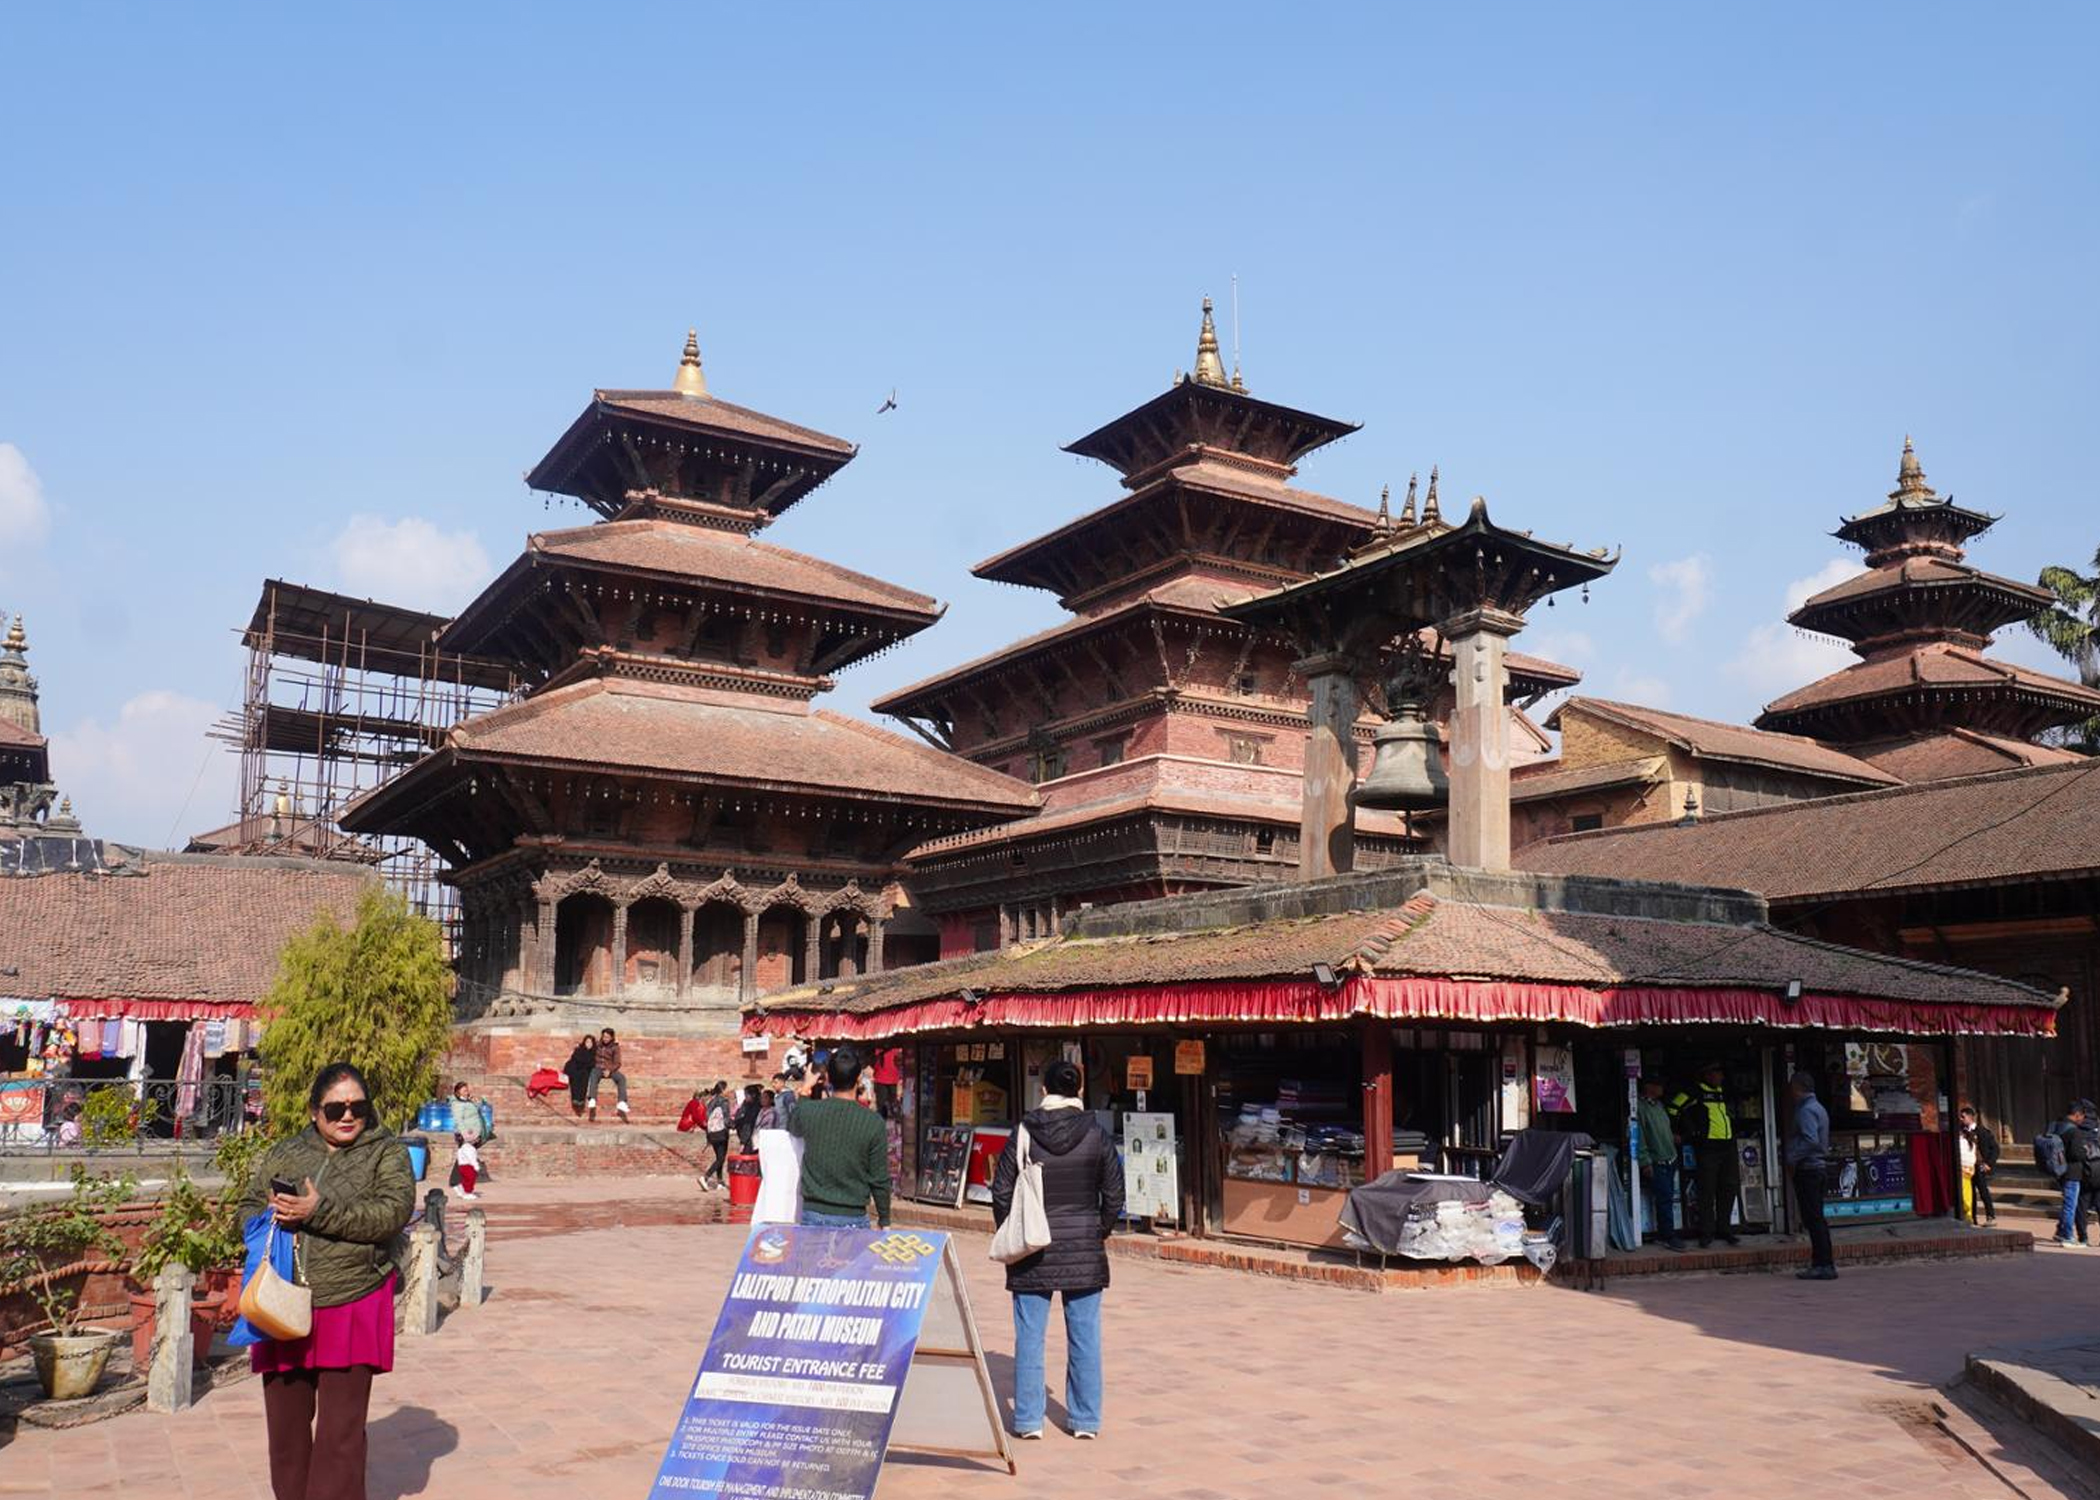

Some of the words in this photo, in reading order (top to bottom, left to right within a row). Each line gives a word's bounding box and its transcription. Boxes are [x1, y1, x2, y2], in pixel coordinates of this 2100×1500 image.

[731, 1273, 795, 1302] LALITPUR
[792, 1276, 893, 1307] METROPOLITAN
[890, 1281, 926, 1309] CITY
[747, 1311, 780, 1338] AND
[777, 1312, 823, 1342] PATAN
[819, 1315, 883, 1346] MUSEUM
[722, 1353, 781, 1372] TOURIST
[782, 1357, 857, 1378] ENTRANCE
[858, 1363, 886, 1380] FEE
[739, 1420, 760, 1429] VALID
[761, 1422, 776, 1430] FOR
[776, 1423, 790, 1432] THE
[812, 1426, 829, 1435] DATE
[735, 1428, 759, 1438] ENTRY
[760, 1430, 784, 1440] PLEASE
[784, 1433, 818, 1443] CONTACT
[819, 1435, 831, 1444] US
[831, 1437, 851, 1446] WITH
[852, 1439, 872, 1448] YOUR
[782, 1442, 798, 1451] SIZE
[798, 1443, 824, 1453] PHOTO
[824, 1446, 835, 1454] AT
[678, 1451, 705, 1460] TICKETS
[705, 1453, 727, 1462] ONCE
[727, 1455, 747, 1463] SOLD
[747, 1456, 764, 1465] CAN
[764, 1458, 780, 1467] NOT
